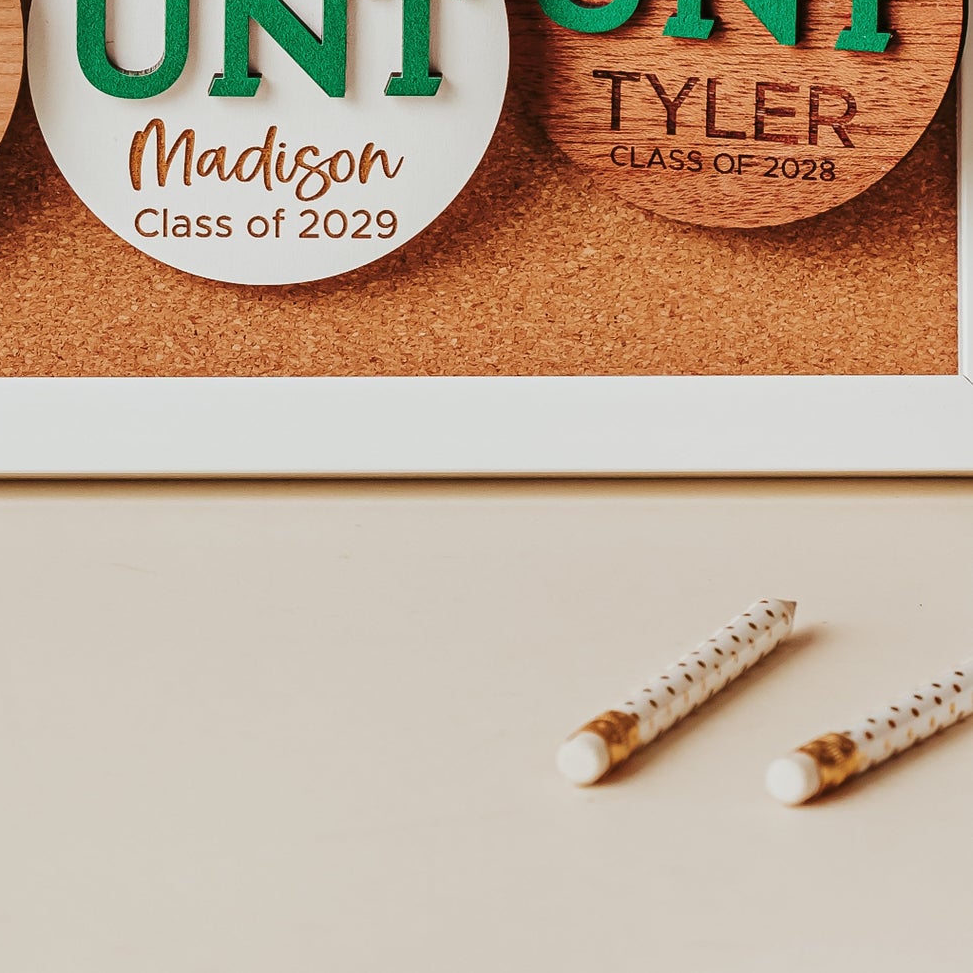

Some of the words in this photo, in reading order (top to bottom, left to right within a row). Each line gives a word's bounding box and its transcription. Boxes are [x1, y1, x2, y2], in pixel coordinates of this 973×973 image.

[592, 70, 858, 149] TYLER
[129, 118, 404, 202] Madison
[610, 145, 703, 173] CLASS
[713, 152, 755, 176] OF
[764, 156, 837, 182] 2028
[134, 208, 233, 239] Class
[246, 208, 286, 239] of
[298, 209, 398, 240] 2029
